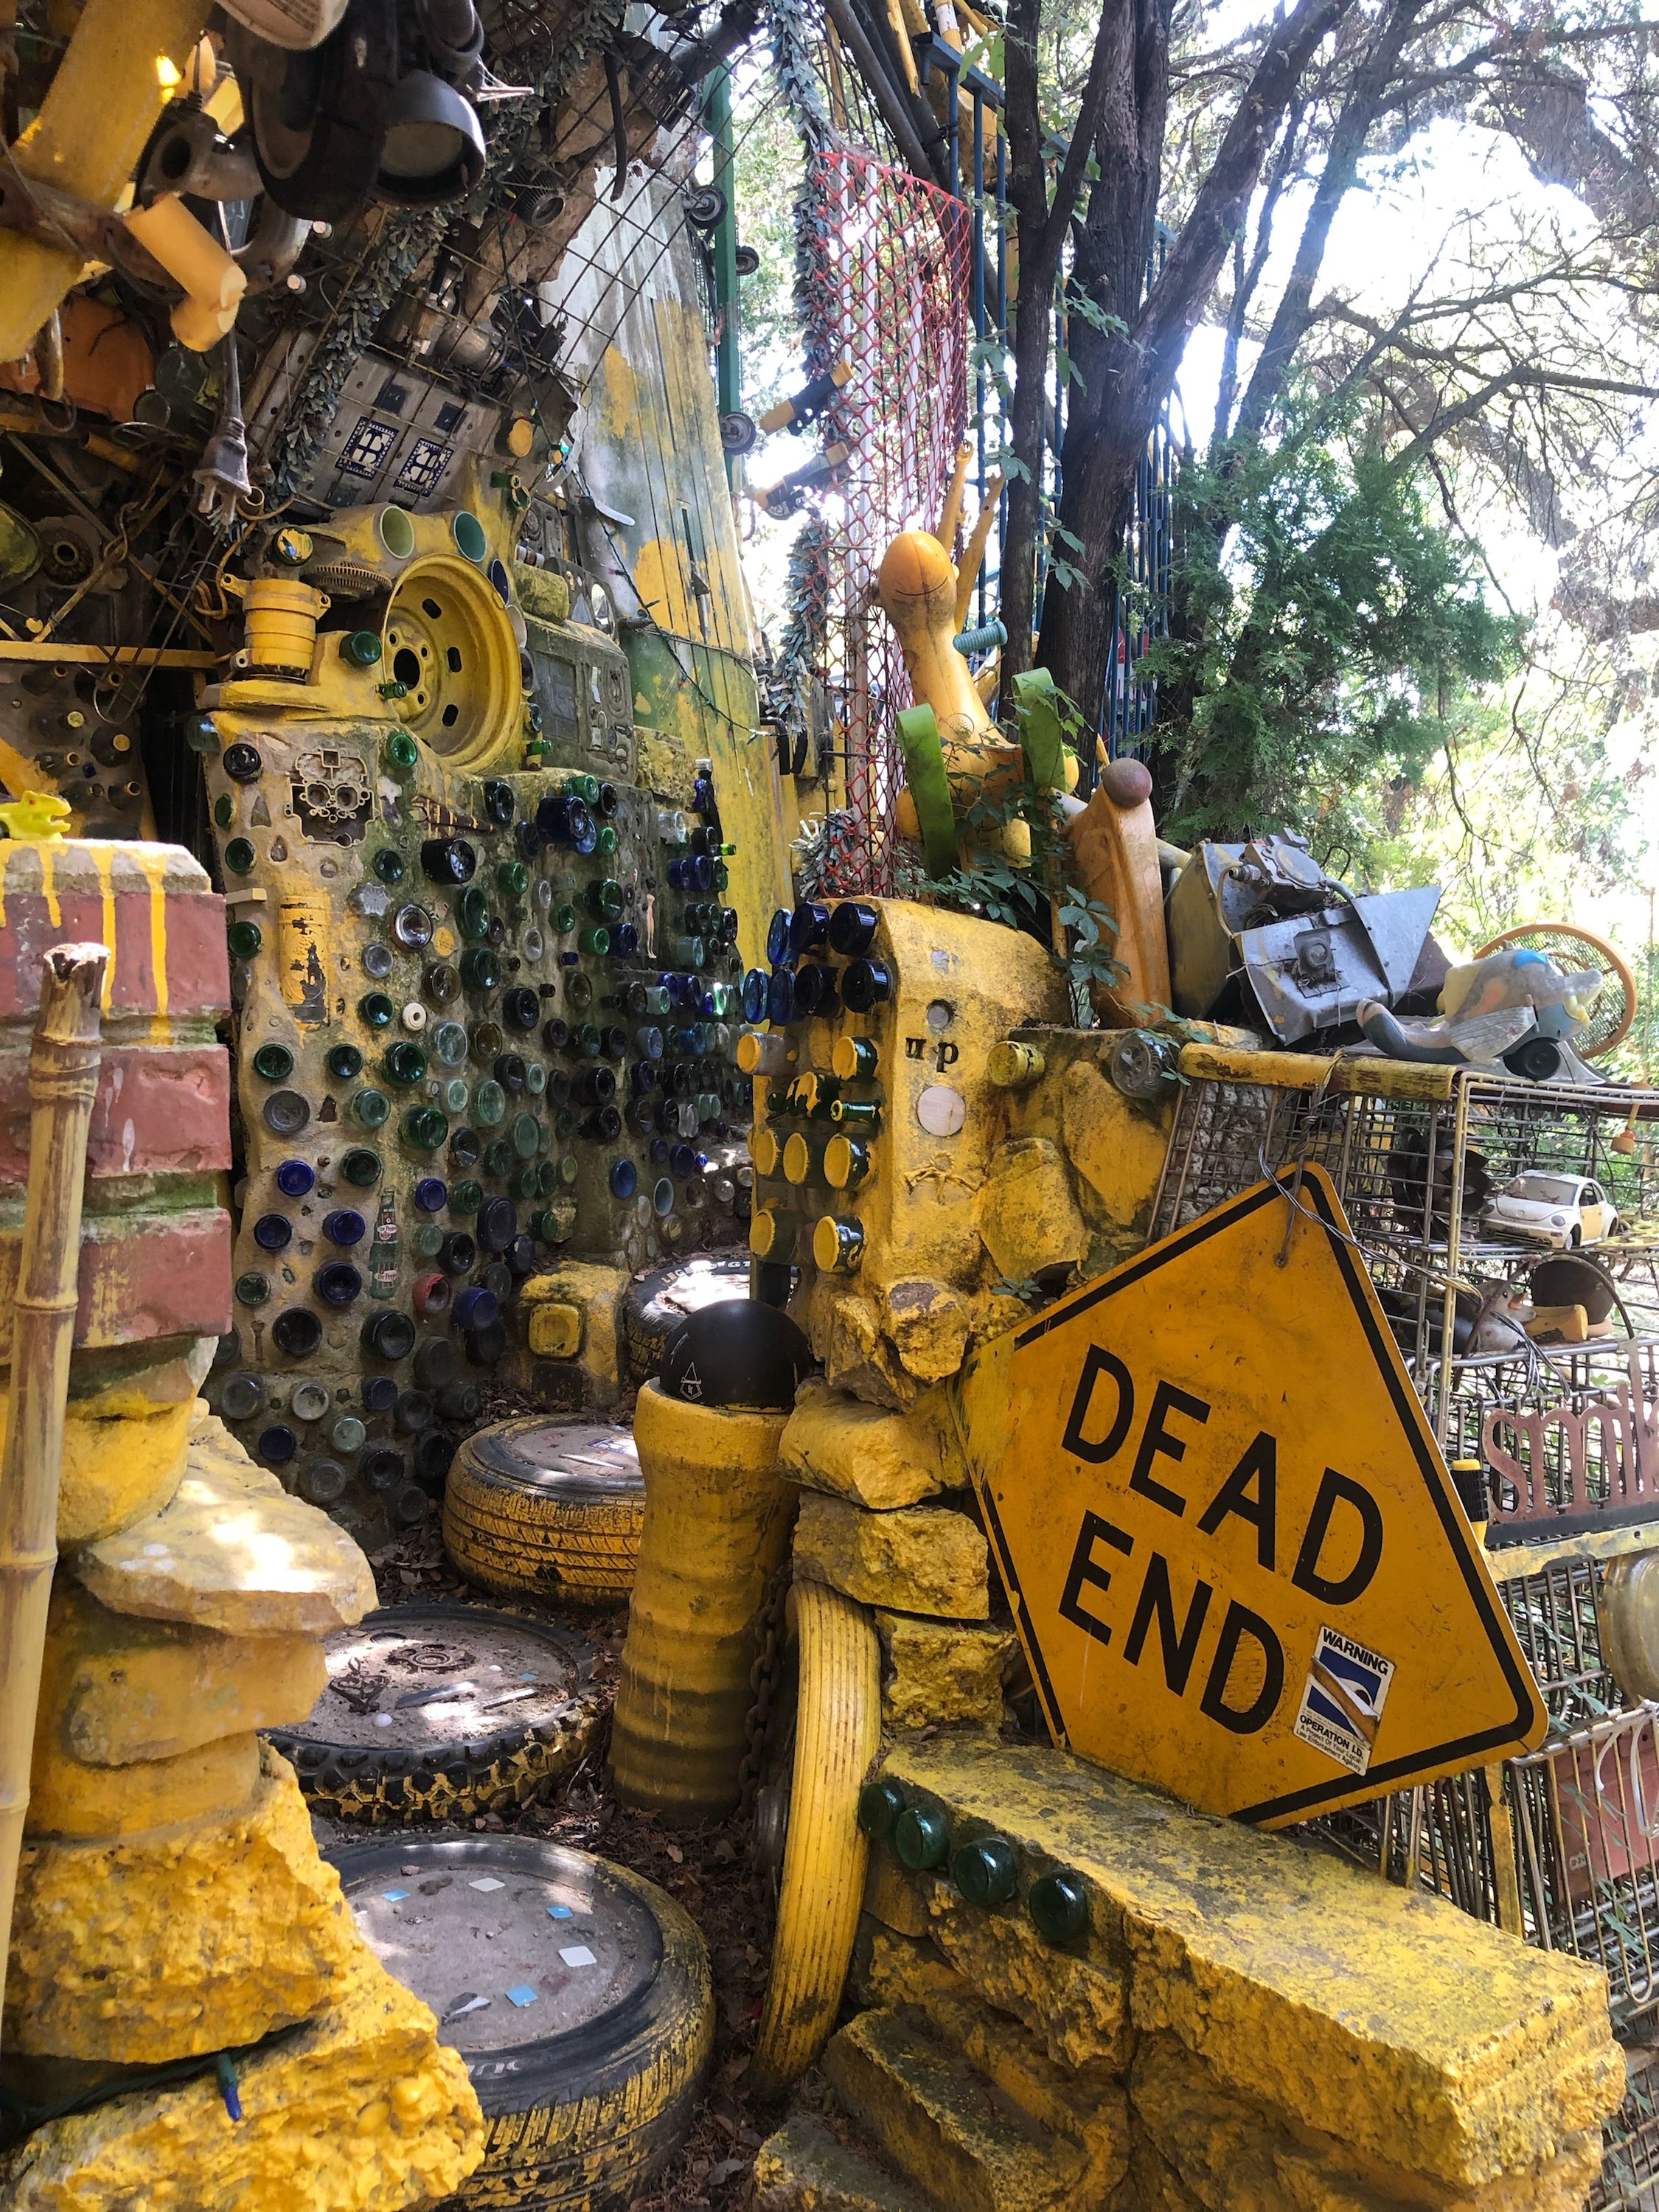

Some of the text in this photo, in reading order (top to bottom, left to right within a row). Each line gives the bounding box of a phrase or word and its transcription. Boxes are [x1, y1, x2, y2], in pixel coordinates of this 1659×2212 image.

[904, 1037, 959, 1073] up
[1482, 1338, 1659, 1525] smil
[1060, 1343, 1384, 1606] DEAD
[1057, 1509, 1285, 1735] END
[1324, 1627, 1389, 1676] WARNING
[1296, 1728, 1362, 1773] Law Enforcement Agency
[1300, 1714, 1350, 1750] OPERATION
[1352, 1745, 1364, 1759] I.D.
[1306, 1726, 1324, 1742] Project
[1325, 1737, 1332, 1746] Of
[1333, 1742, 1346, 1754] Your
[1346, 1750, 1361, 1764] Local
